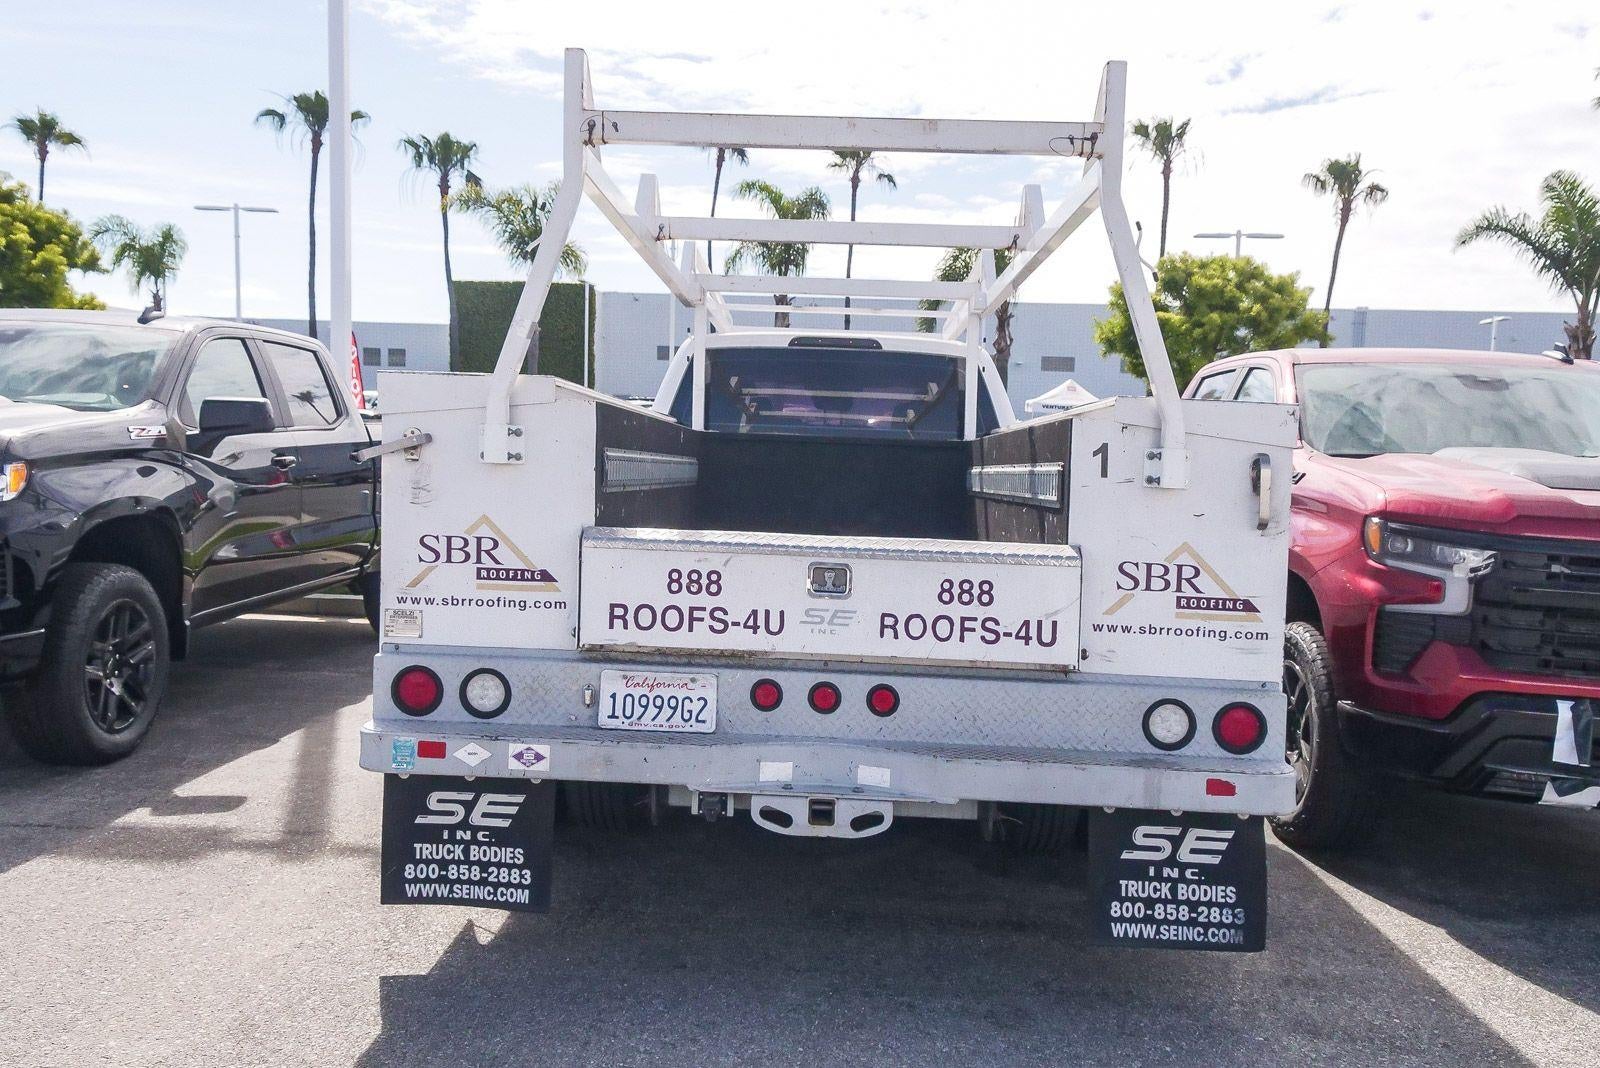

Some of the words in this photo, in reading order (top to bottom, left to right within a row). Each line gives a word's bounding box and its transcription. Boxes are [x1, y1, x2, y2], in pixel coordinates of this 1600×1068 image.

[1093, 443, 1108, 478] 1
[417, 533, 504, 565] SBR
[480, 569, 542, 580] ROOFING
[666, 568, 723, 596] 888
[1116, 561, 1206, 594] SBR
[396, 594, 567, 611] www.sbrroofing.com
[937, 579, 995, 607] 888
[1180, 598, 1244, 610] ROOFING
[608, 602, 785, 637] ROOFS-4U
[799, 608, 857, 626] SE
[879, 613, 1059, 648] ROOFS-4U
[1092, 623, 1269, 641] www.sbrroofing.com
[624, 675, 695, 693] California
[606, 692, 709, 724] 10999G2
[627, 721, 687, 729] dmv.ca.gov
[414, 791, 527, 828] SE
[443, 829, 496, 842] INC.
[1120, 825, 1236, 865] SE
[414, 843, 465, 860] TRUCK
[470, 845, 525, 865] BODIES
[404, 863, 532, 885] 800-858-2883
[1149, 866, 1205, 880] INC.
[405, 883, 530, 904] WWW.SEINC.COM
[1119, 880, 1172, 900] TRUCK
[1178, 883, 1237, 904] BODIES
[1110, 901, 1246, 925] 800-858-2883
[1111, 922, 1244, 944] WWW.SEINC.COM
